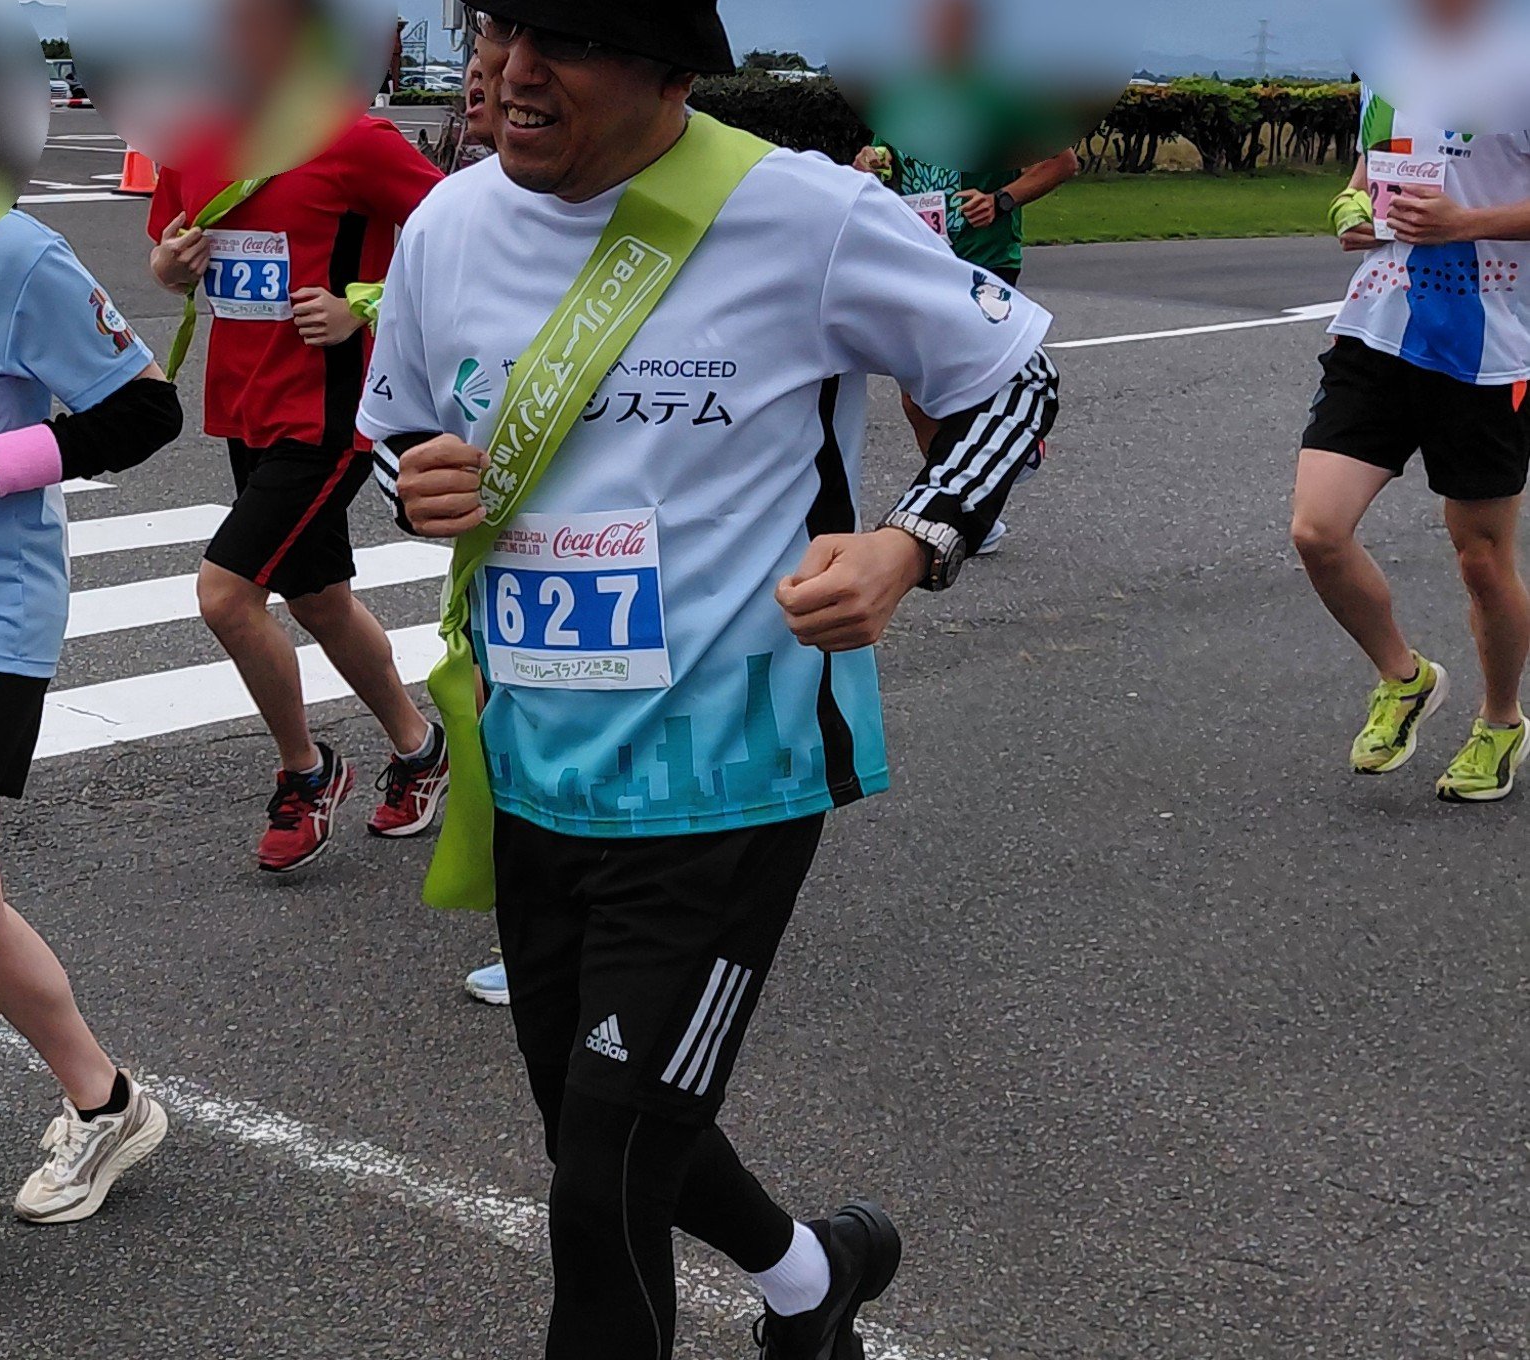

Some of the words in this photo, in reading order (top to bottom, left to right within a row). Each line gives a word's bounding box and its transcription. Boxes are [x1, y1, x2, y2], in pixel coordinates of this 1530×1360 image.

[209, 261, 281, 300] 723
[606, 359, 737, 378] へ-PROCEED
[582, 390, 733, 427] システム
[552, 519, 651, 559] Coca-Cola
[496, 572, 639, 647] 627
[585, 1034, 629, 1062] adidas
